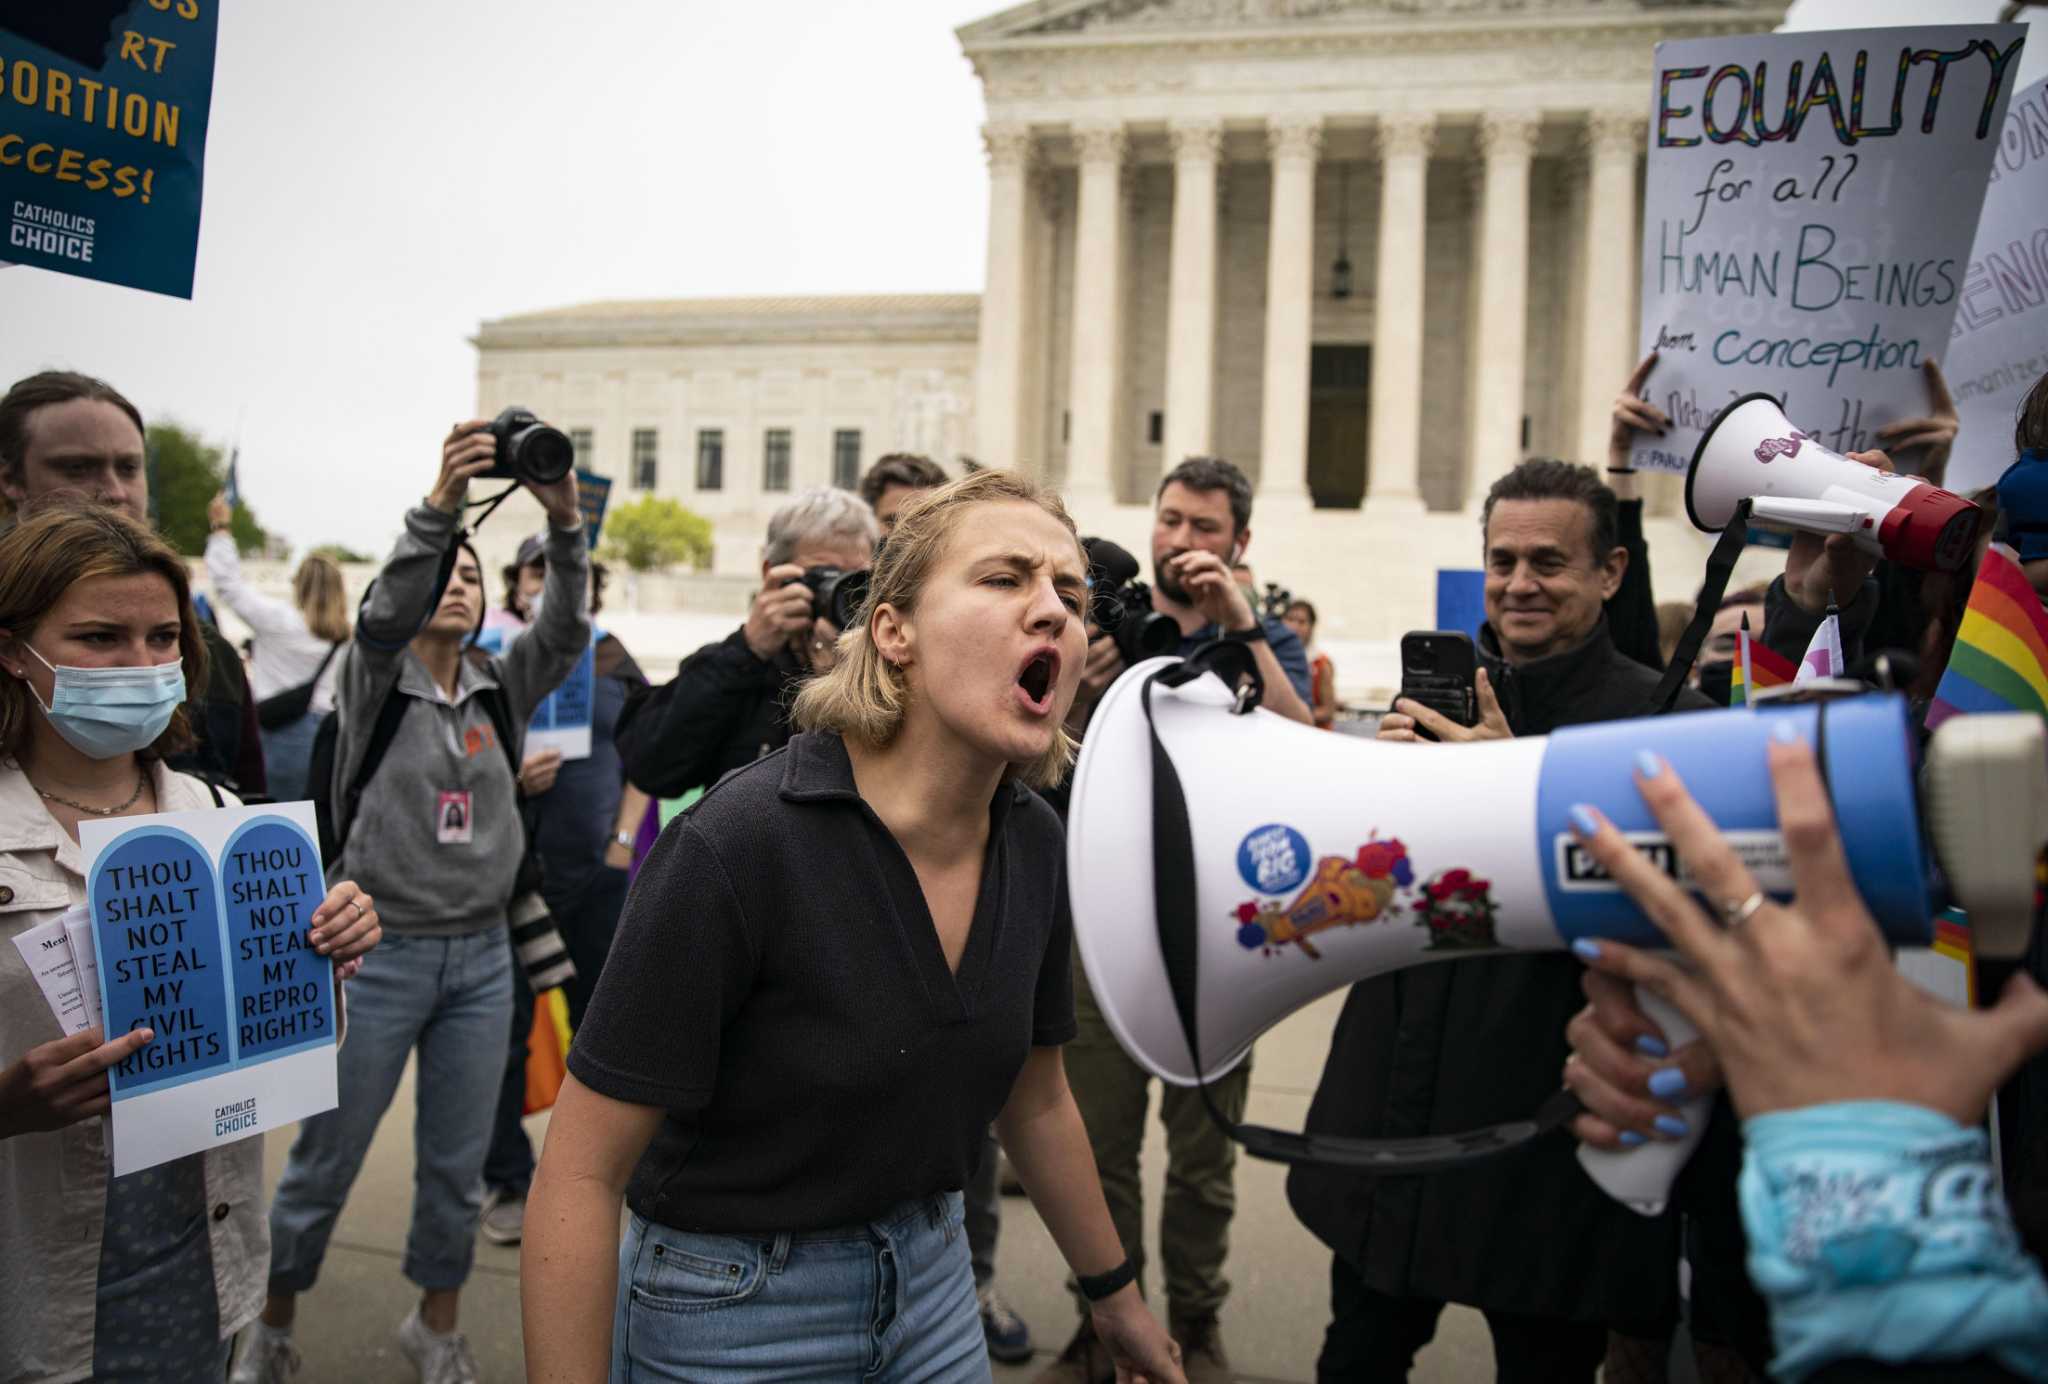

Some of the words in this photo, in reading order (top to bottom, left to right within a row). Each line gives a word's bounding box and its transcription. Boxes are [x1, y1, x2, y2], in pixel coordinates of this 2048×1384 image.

[147, 0, 199, 20] S
[120, 30, 177, 73] RT
[0, 58, 181, 148] ORTION
[1658, 37, 2026, 147] EQUALITY
[1684, 158, 1752, 236] for
[1773, 153, 1858, 203] all
[13, 200, 96, 235] CATHOLICS
[10, 223, 95, 263] CHOICE
[1659, 219, 1780, 298] HUMAN
[1791, 223, 1955, 312] BEINGS
[1712, 323, 1922, 389] Conception
[106, 859, 192, 892] THOU
[232, 847, 302, 876] THOU
[105, 887, 200, 923] SHALT
[232, 873, 309, 904] SHALT
[250, 902, 300, 931] NOT
[127, 919, 187, 951] NOT
[240, 930, 315, 961] STEAL
[115, 947, 207, 984] STEAL
[262, 958, 297, 986] MY
[143, 979, 184, 1010] MY
[242, 981, 319, 1019] REPRO
[239, 1007, 325, 1048] RIGHTS
[117, 1031, 220, 1078] RIGHTS
[214, 1097, 256, 1120] CATHOLICS
[215, 1112, 257, 1137] CHOICE
